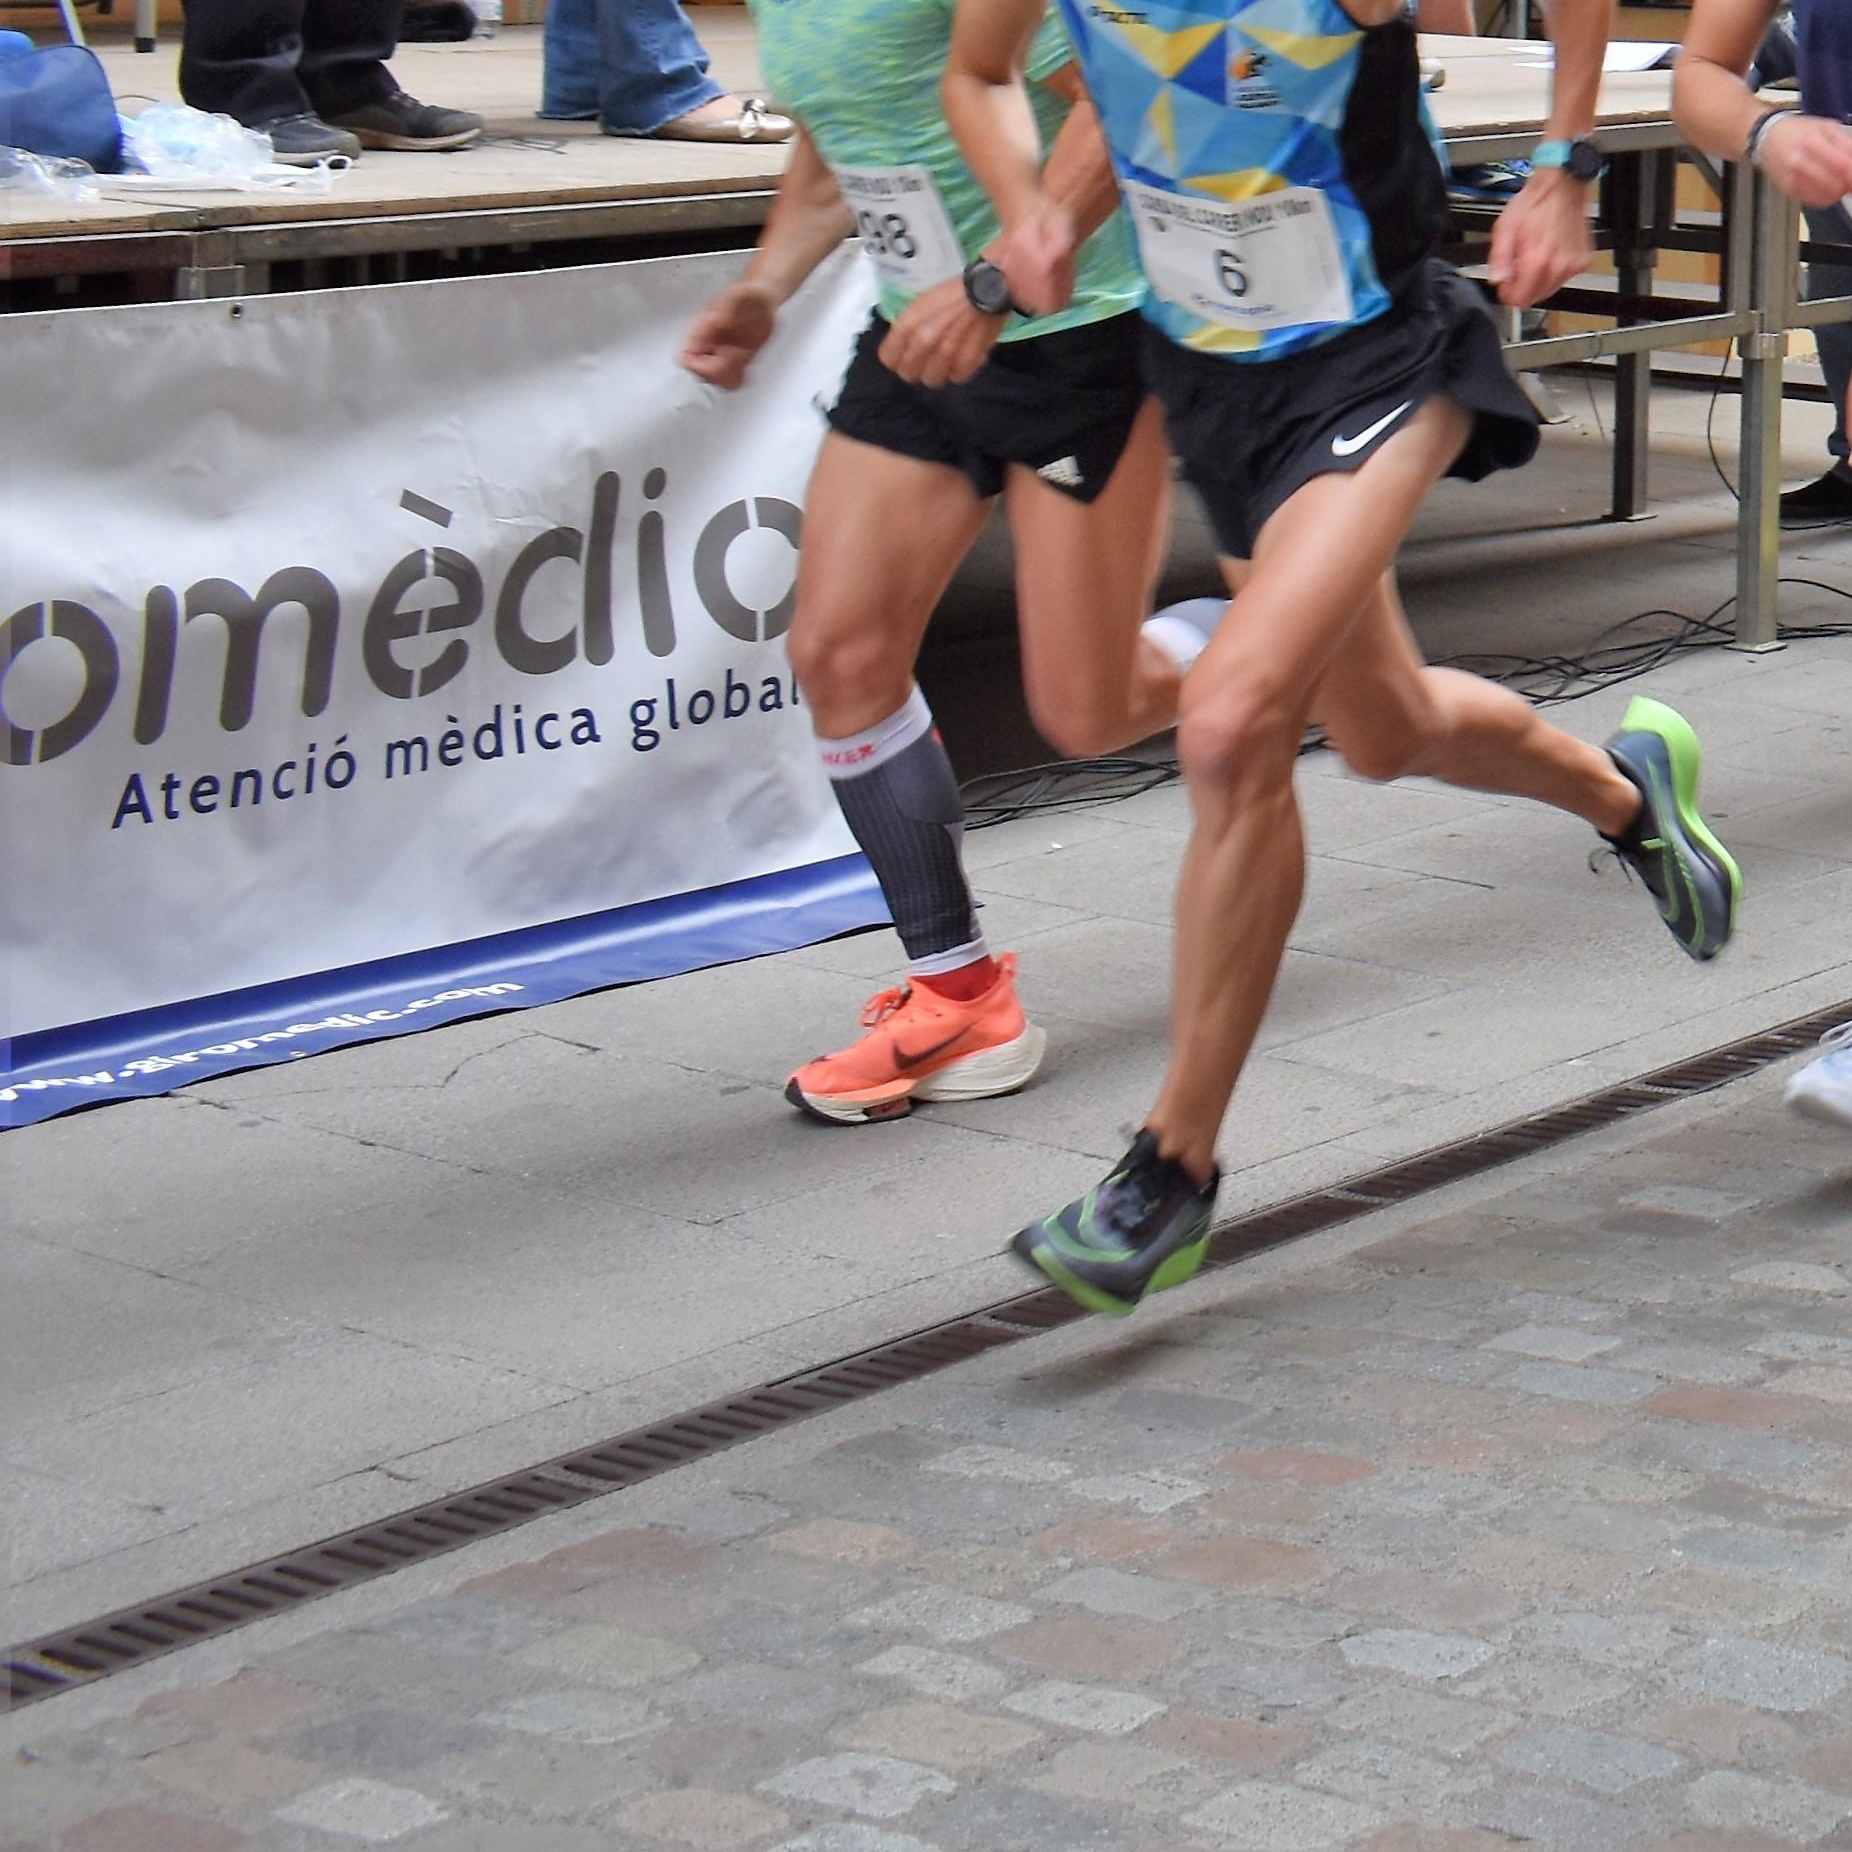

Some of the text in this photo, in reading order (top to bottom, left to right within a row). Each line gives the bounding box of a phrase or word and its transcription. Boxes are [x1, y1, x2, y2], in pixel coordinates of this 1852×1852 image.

[1214, 248, 1248, 298] 6
[111, 666, 802, 832] Atenció mèdica global
